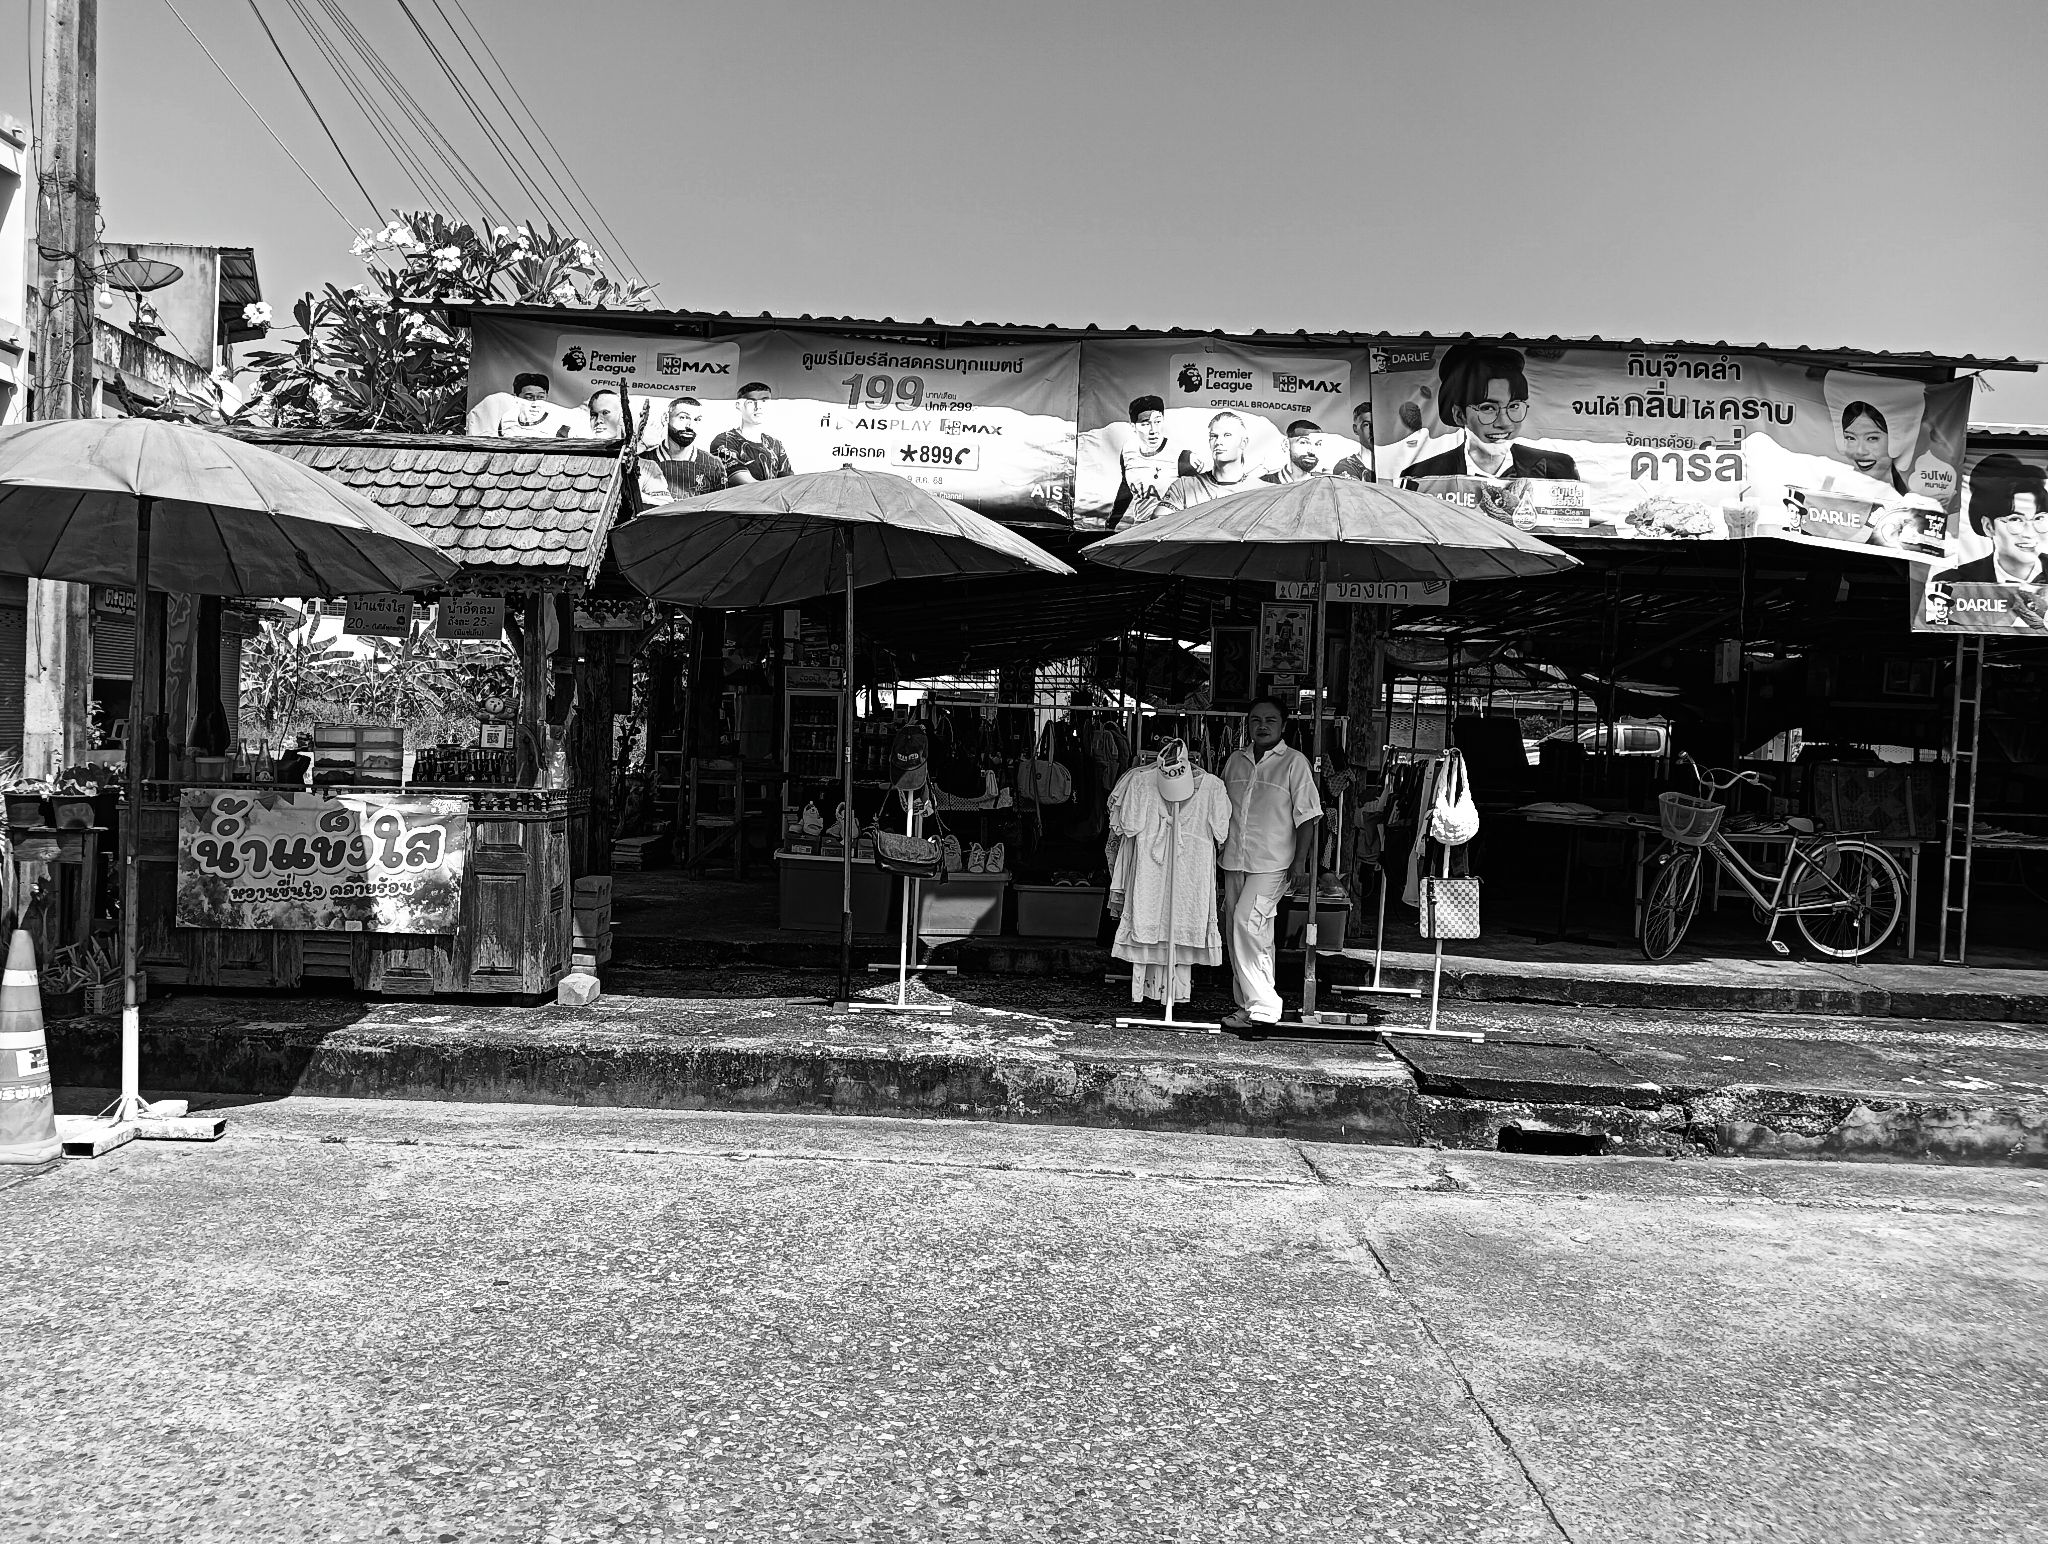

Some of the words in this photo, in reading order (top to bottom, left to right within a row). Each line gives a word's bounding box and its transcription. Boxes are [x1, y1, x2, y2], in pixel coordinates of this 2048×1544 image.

[590, 350, 637, 363] Premier
[801, 349, 1024, 374] ดูพรีเมียร์ลีกสดครบทุกแมตช์
[1392, 352, 1430, 364] DARLIE
[589, 361, 636, 375] League
[682, 361, 731, 375] MAX
[1627, 350, 1742, 381] กินจ๊าดลำ
[1206, 367, 1253, 380] Premier
[631, 381, 697, 392] BROADCASTER
[842, 373, 925, 411] 199
[1205, 379, 1253, 393] League
[1298, 379, 1342, 393] MAX
[1210, 399, 1250, 408] OFFICIAL
[1250, 400, 1312, 413] BROADCASTER
[1625, 432, 1694, 450] จัดการด้วย
[832, 444, 885, 458] สมัครกด
[1030, 483, 1063, 501] AIS
[1809, 507, 1861, 528] DARLIE
[1955, 598, 2008, 613] DARLIE
[193, 796, 444, 874] น้ำแข็งใส
[230, 873, 327, 900] หวานชื่นใจ
